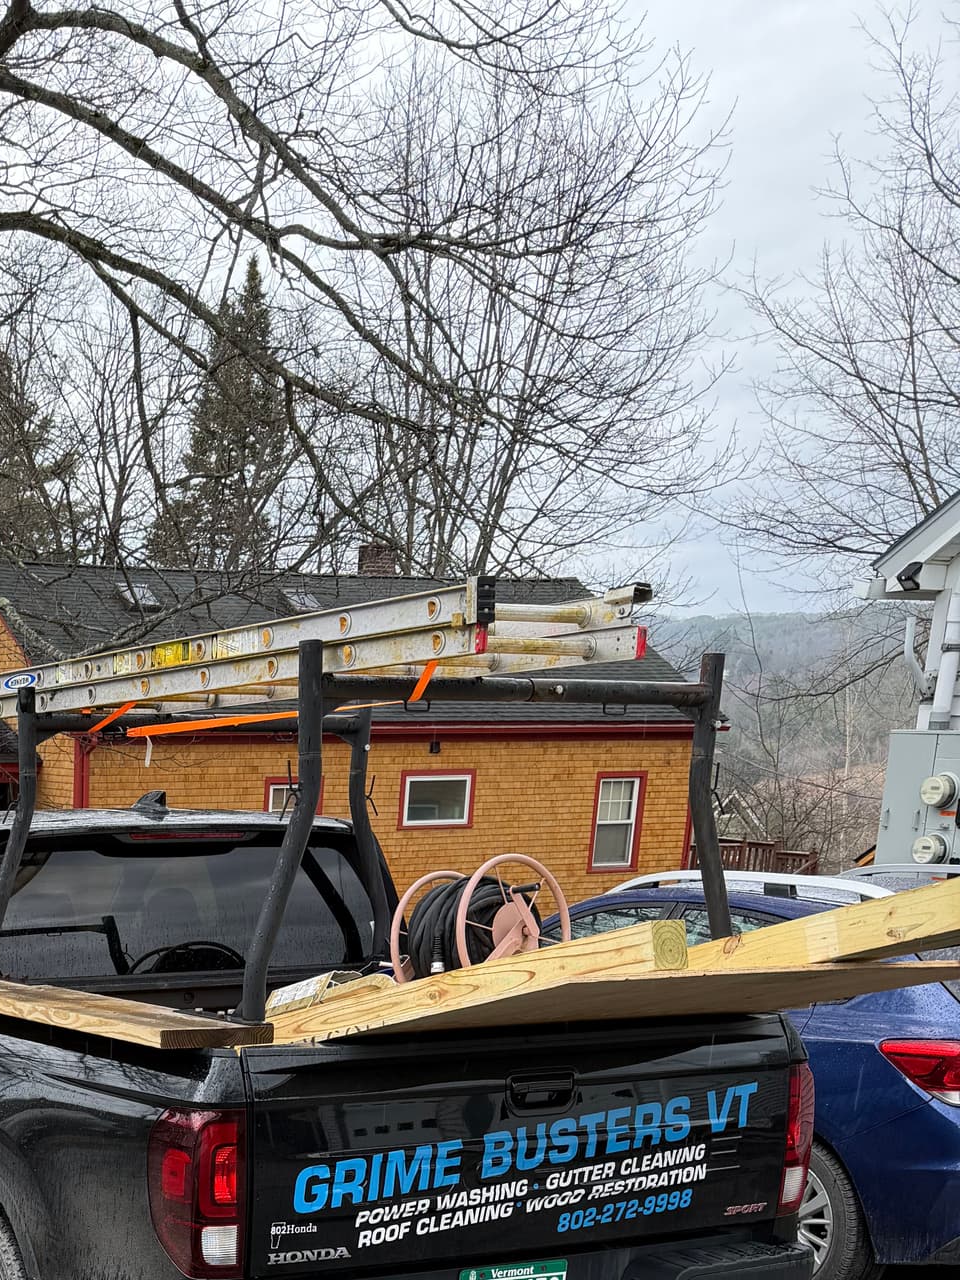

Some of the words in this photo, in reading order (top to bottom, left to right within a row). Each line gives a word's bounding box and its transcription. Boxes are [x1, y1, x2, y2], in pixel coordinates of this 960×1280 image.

[293, 1139, 464, 1214] GRIME
[480, 1096, 692, 1180] BUSTERS
[706, 1081, 759, 1134] VT
[355, 1199, 431, 1228] POWER
[436, 1179, 529, 1212] WASHING
[545, 1164, 616, 1190] GUTTER
[620, 1143, 707, 1176] CLEANING
[357, 1221, 412, 1249] ROOF
[416, 1201, 515, 1236] CLEANING
[525, 1190, 586, 1214] WOOD
[587, 1164, 707, 1200] RESTORATION
[556, 1188, 693, 1233] 802-272-9998
[724, 1202, 768, 1216] SPORT
[267, 1246, 352, 1265] HONDA
[491, 1266, 535, 1279] Vermont
